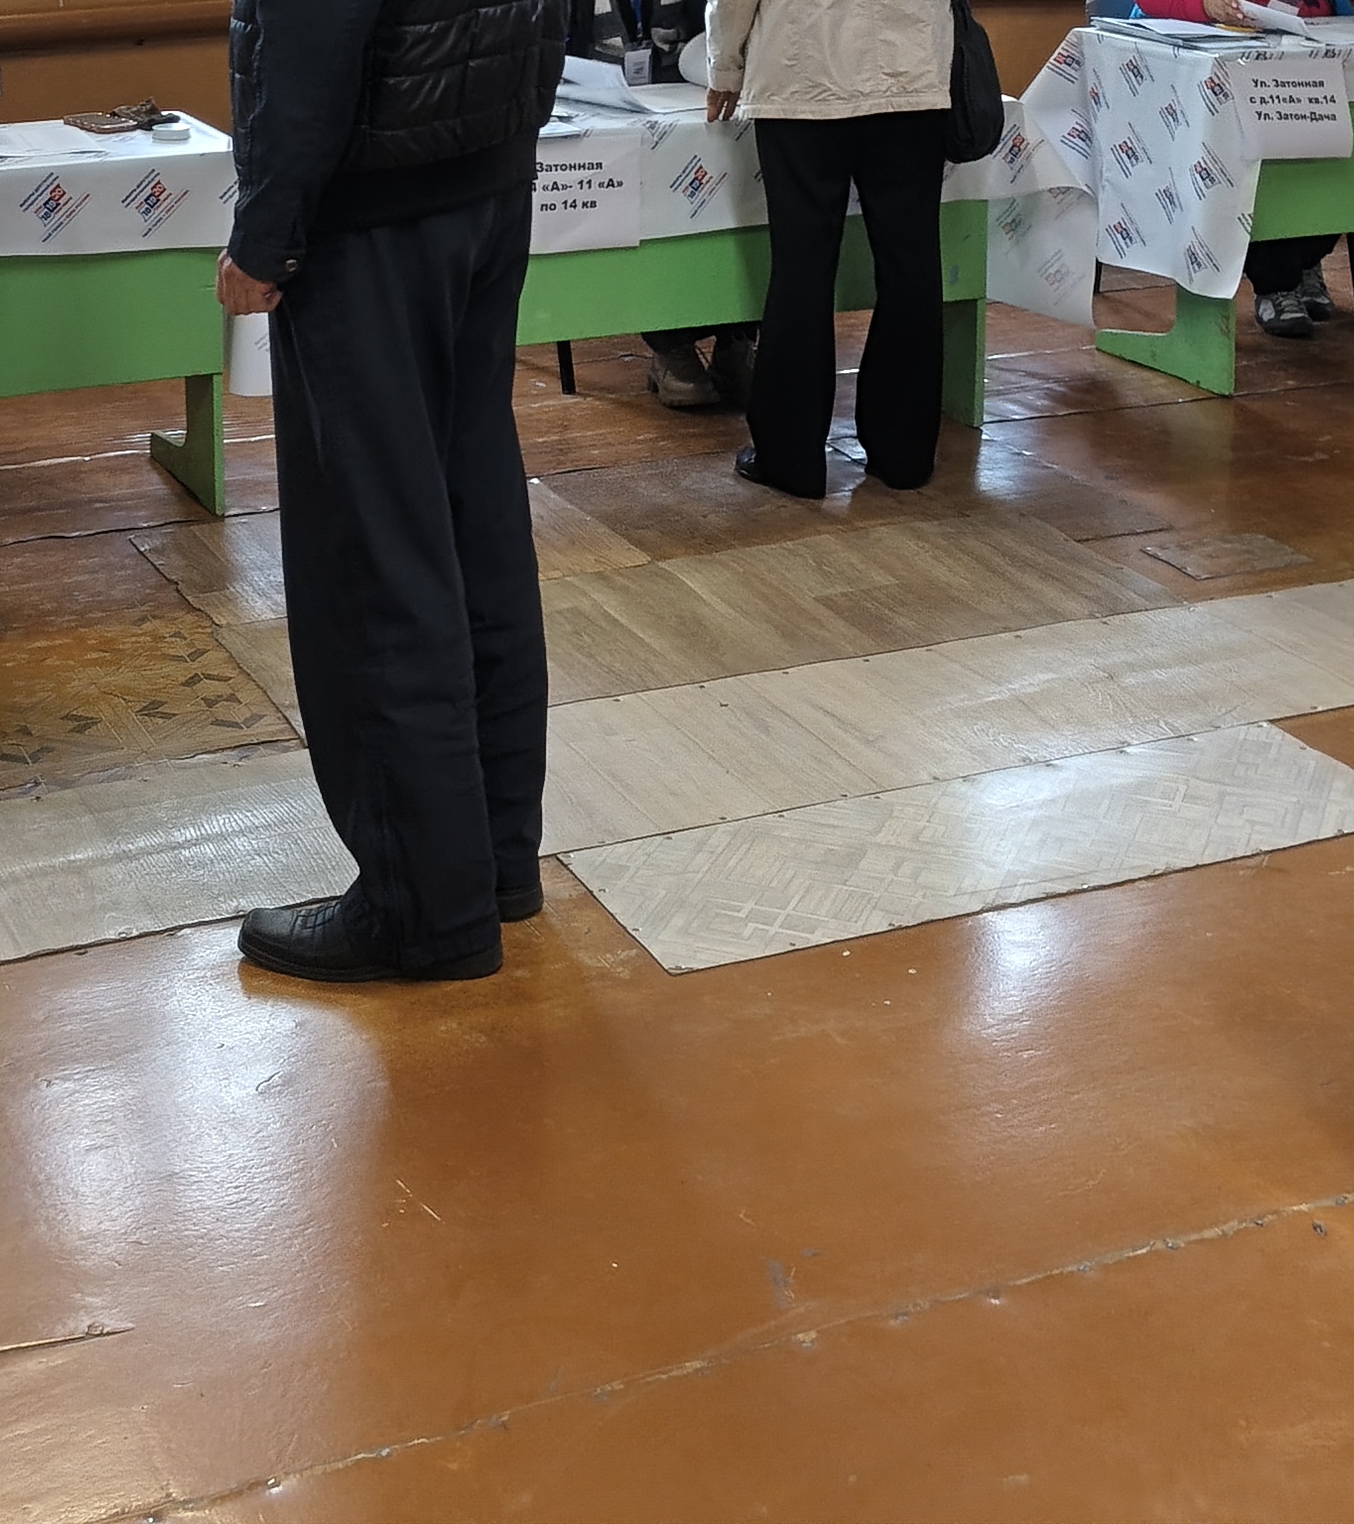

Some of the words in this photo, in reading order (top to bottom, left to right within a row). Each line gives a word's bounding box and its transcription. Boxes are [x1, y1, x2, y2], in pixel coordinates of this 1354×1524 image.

[1272, 78, 1325, 89] Затонная
[1249, 96, 1257, 104] с
[535, 161, 604, 173] Затонная
[577, 179, 593, 191] 11
[598, 177, 624, 190] «А»
[540, 202, 557, 212] по
[562, 198, 578, 210] 14
[581, 199, 598, 209] кв
